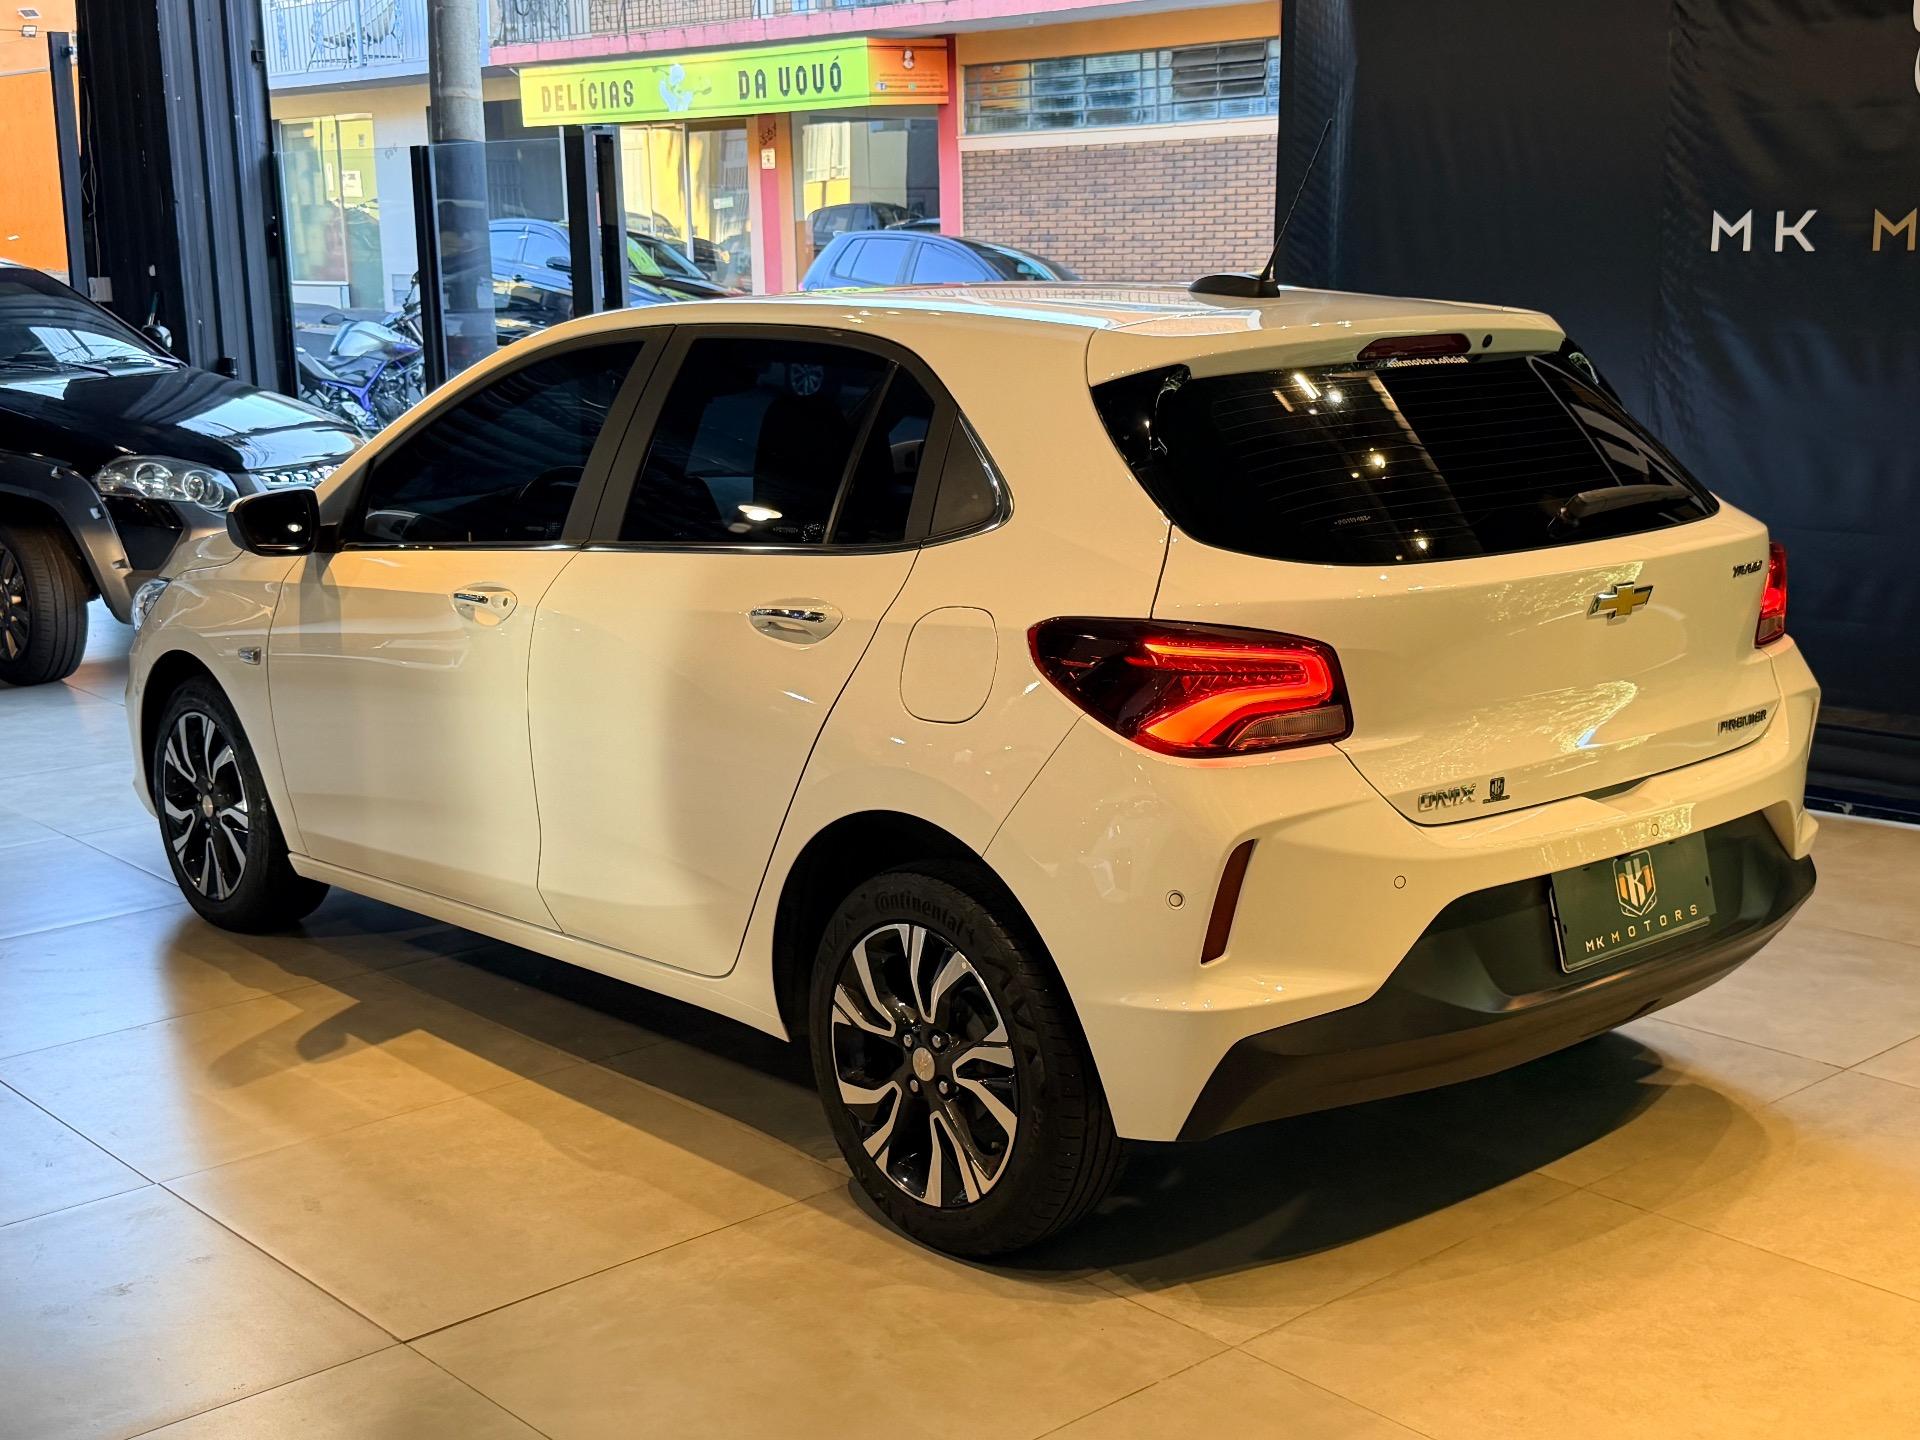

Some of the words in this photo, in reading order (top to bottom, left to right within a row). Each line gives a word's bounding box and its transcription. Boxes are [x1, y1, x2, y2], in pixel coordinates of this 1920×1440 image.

[541, 78, 634, 113] DELÍCIAS
[738, 68, 767, 100] DA
[1710, 209, 1818, 252] MK
[876, 890, 964, 937] Continental
